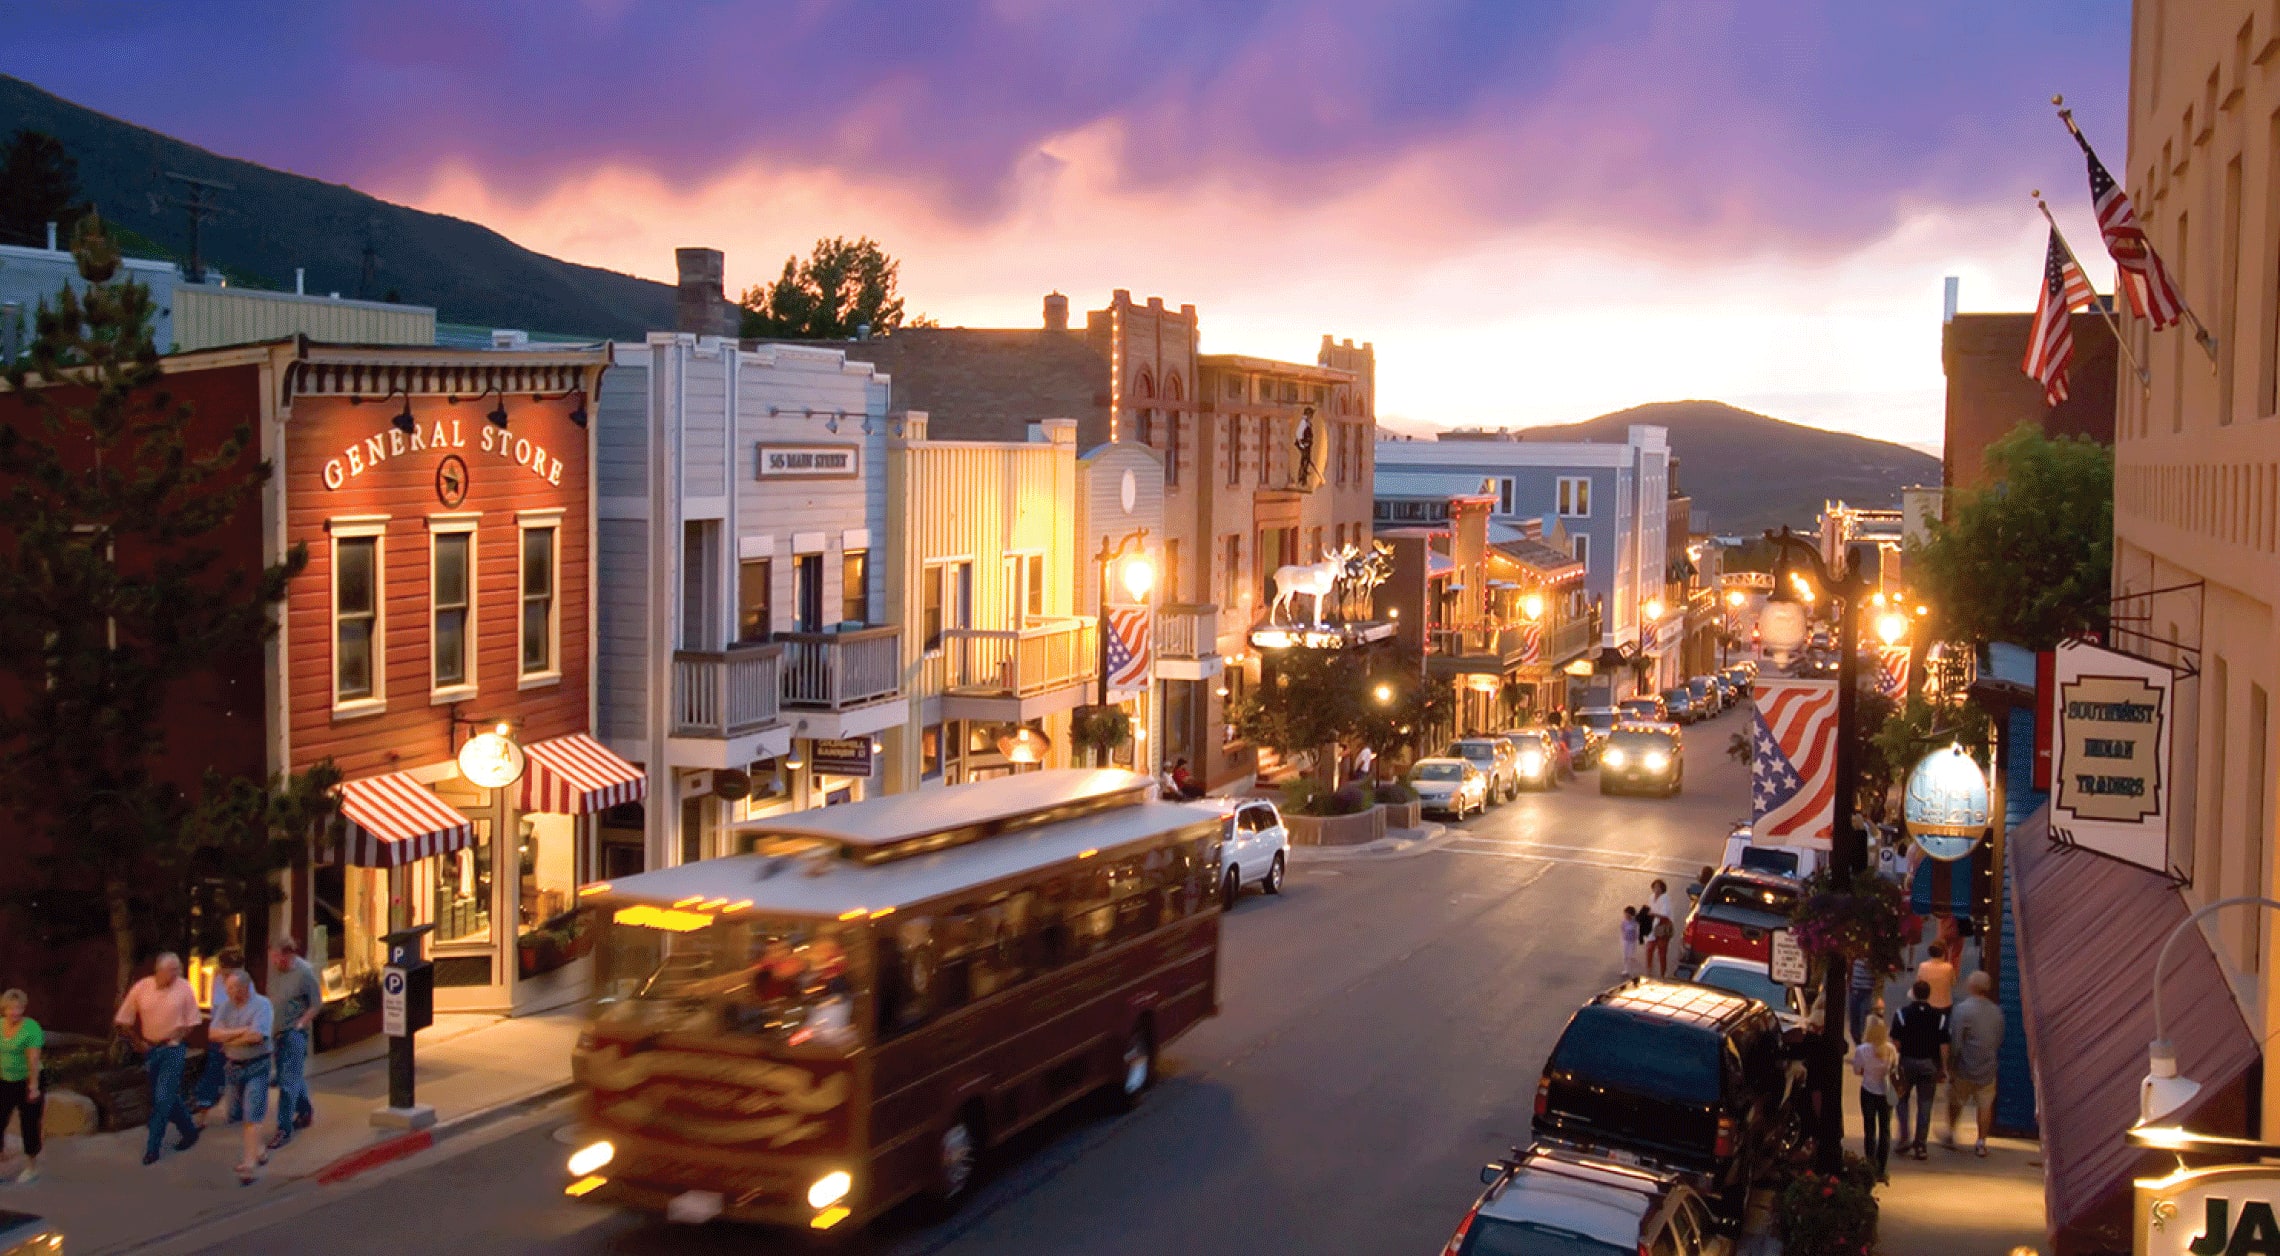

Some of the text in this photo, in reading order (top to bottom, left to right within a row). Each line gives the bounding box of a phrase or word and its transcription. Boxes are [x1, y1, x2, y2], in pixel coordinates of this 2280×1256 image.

[324, 420, 564, 489] GENERAL STORE
[787, 453, 814, 469] MAIN
[815, 453, 848, 469] STREET
[2068, 700, 2155, 723] SOUTHWEST
[2084, 738, 2136, 760] INDIAN
[2076, 774, 2145, 798] TRADERS
[394, 946, 404, 963] P
[389, 975, 401, 991] P
